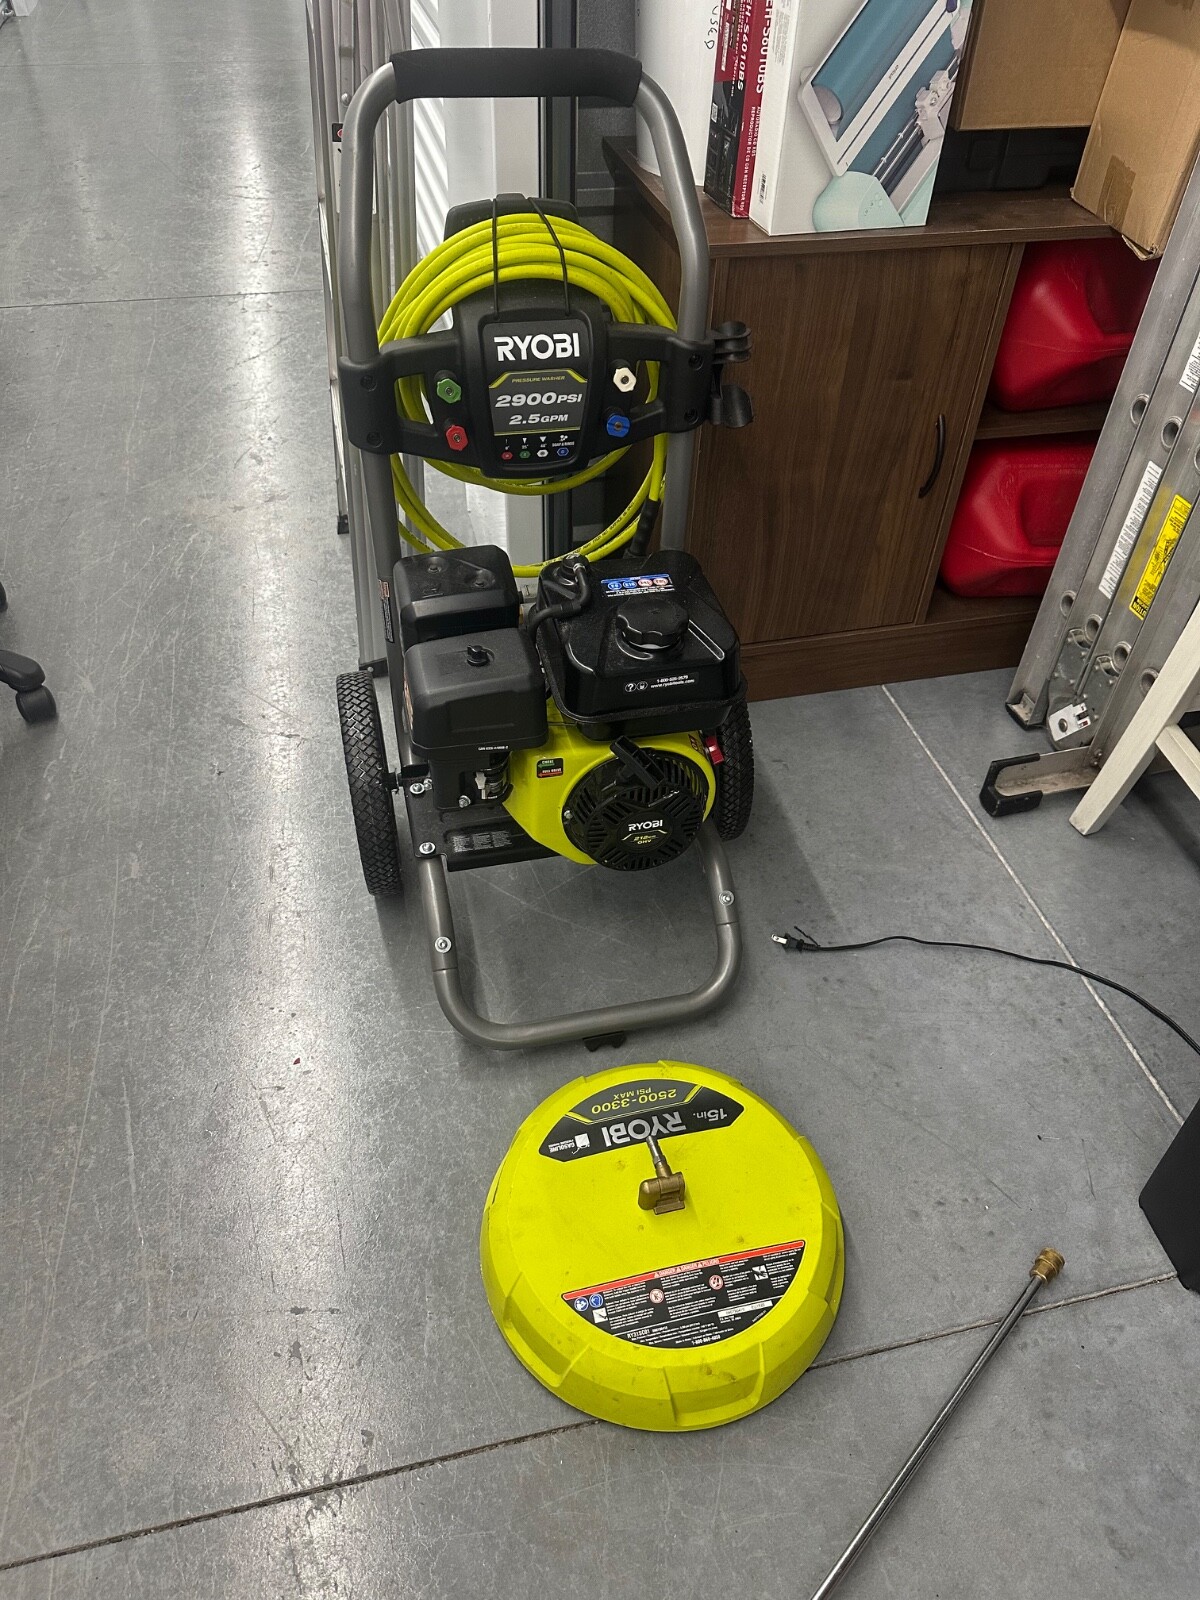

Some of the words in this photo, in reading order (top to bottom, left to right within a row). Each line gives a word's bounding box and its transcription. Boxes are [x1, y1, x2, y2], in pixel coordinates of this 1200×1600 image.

[494, 332, 580, 362] RYOBI
[628, 819, 663, 831] RYOBI
[613, 1089, 635, 1100] MAX
[636, 1087, 652, 1096] PSI
[601, 1110, 687, 1147] RYOBI
[548, 1141, 576, 1153] GASOLINE
